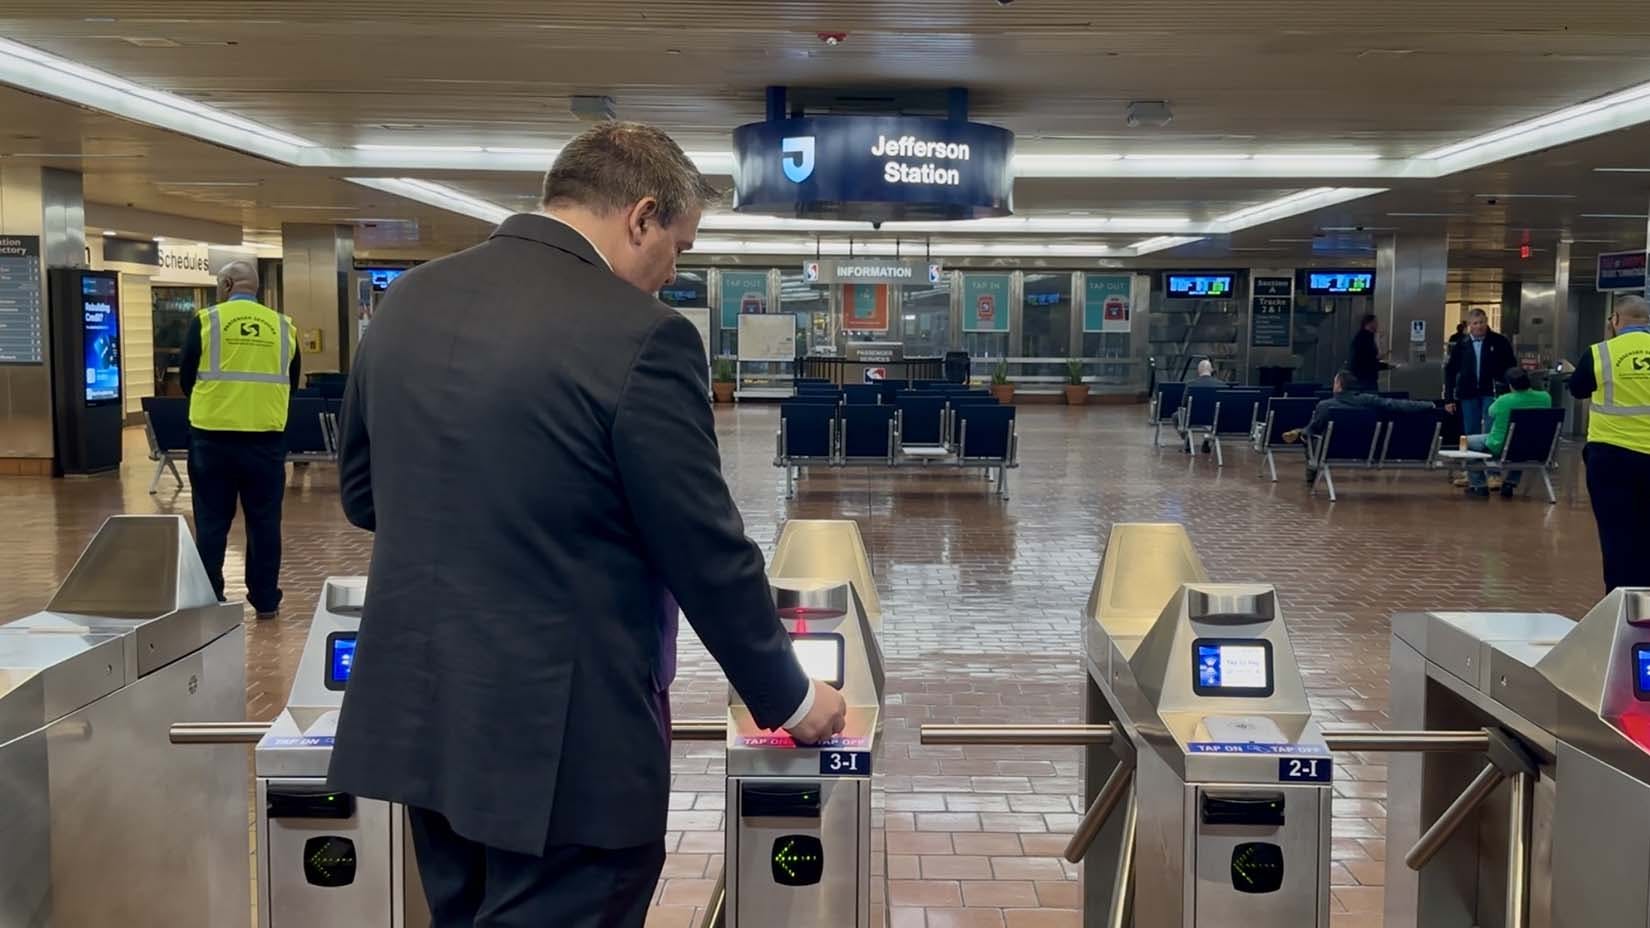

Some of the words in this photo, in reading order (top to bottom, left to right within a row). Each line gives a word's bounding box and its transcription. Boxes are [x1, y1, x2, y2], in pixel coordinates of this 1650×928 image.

[871, 135, 970, 160] Jefferson
[884, 161, 960, 185] Station
[158, 248, 209, 271] Schedules
[837, 266, 912, 278] INFORMATION
[744, 738, 768, 746] TAP
[842, 738, 866, 746] OFF
[1198, 744, 1222, 752] TAP
[1225, 744, 1244, 752] ON
[1270, 745, 1295, 753] TAP
[1297, 746, 1323, 754] OFF
[830, 753, 858, 770] 3-I
[1289, 760, 1318, 777] 2-I
